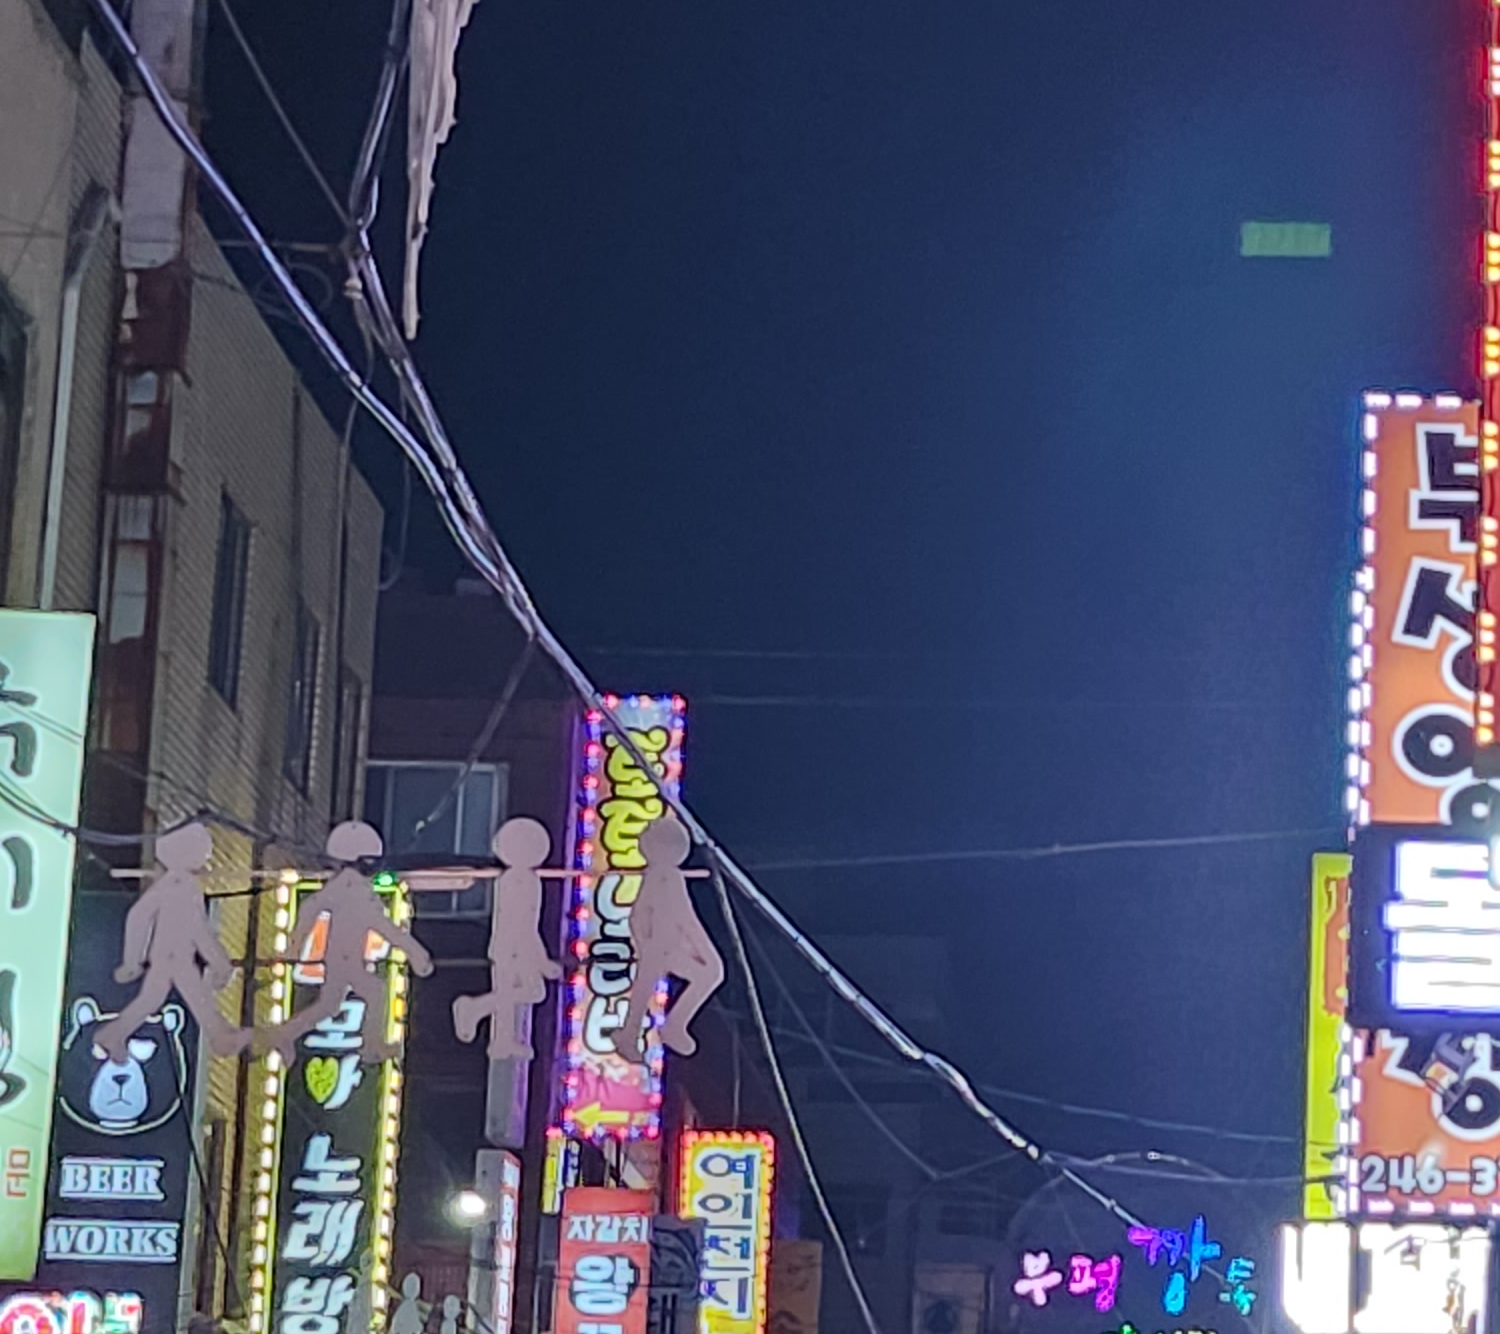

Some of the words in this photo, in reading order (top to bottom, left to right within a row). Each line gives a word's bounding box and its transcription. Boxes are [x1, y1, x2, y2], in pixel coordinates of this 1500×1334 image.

[61, 1162, 163, 1196] BEER
[46, 1224, 179, 1258] WORKS
[567, 1213, 649, 1244] 자갈치
[1013, 1251, 1122, 1313] 부평
